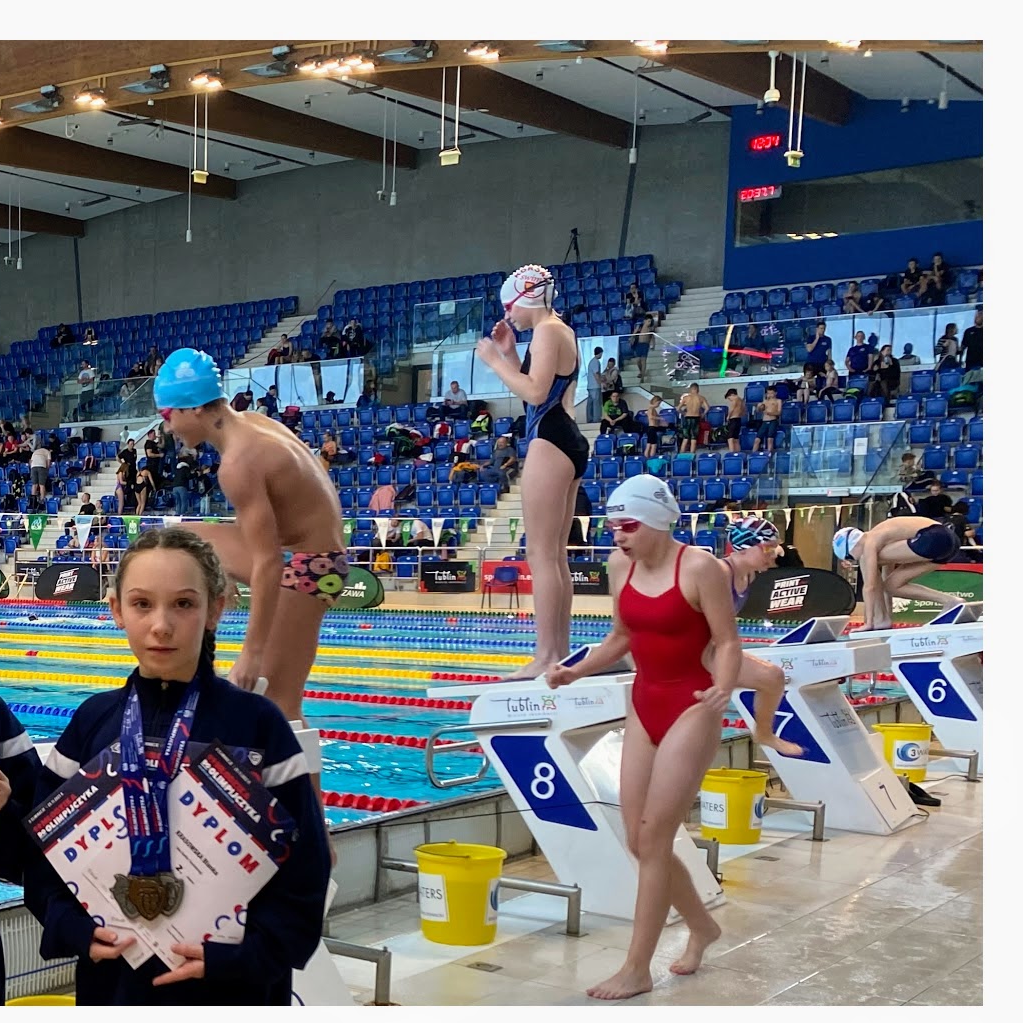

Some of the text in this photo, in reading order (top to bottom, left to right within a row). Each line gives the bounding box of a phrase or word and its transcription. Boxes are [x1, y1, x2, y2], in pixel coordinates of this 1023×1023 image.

[774, 578, 801, 590] PRINT
[341, 589, 365, 599] ZAWA
[772, 585, 807, 600] ACTIVE
[769, 596, 804, 609] WEAR
[927, 678, 948, 703] 6
[774, 711, 794, 737] 7
[530, 762, 556, 800] 8
[702, 803, 725, 813] ATERS
[179, 789, 260, 875] DYPLOM
